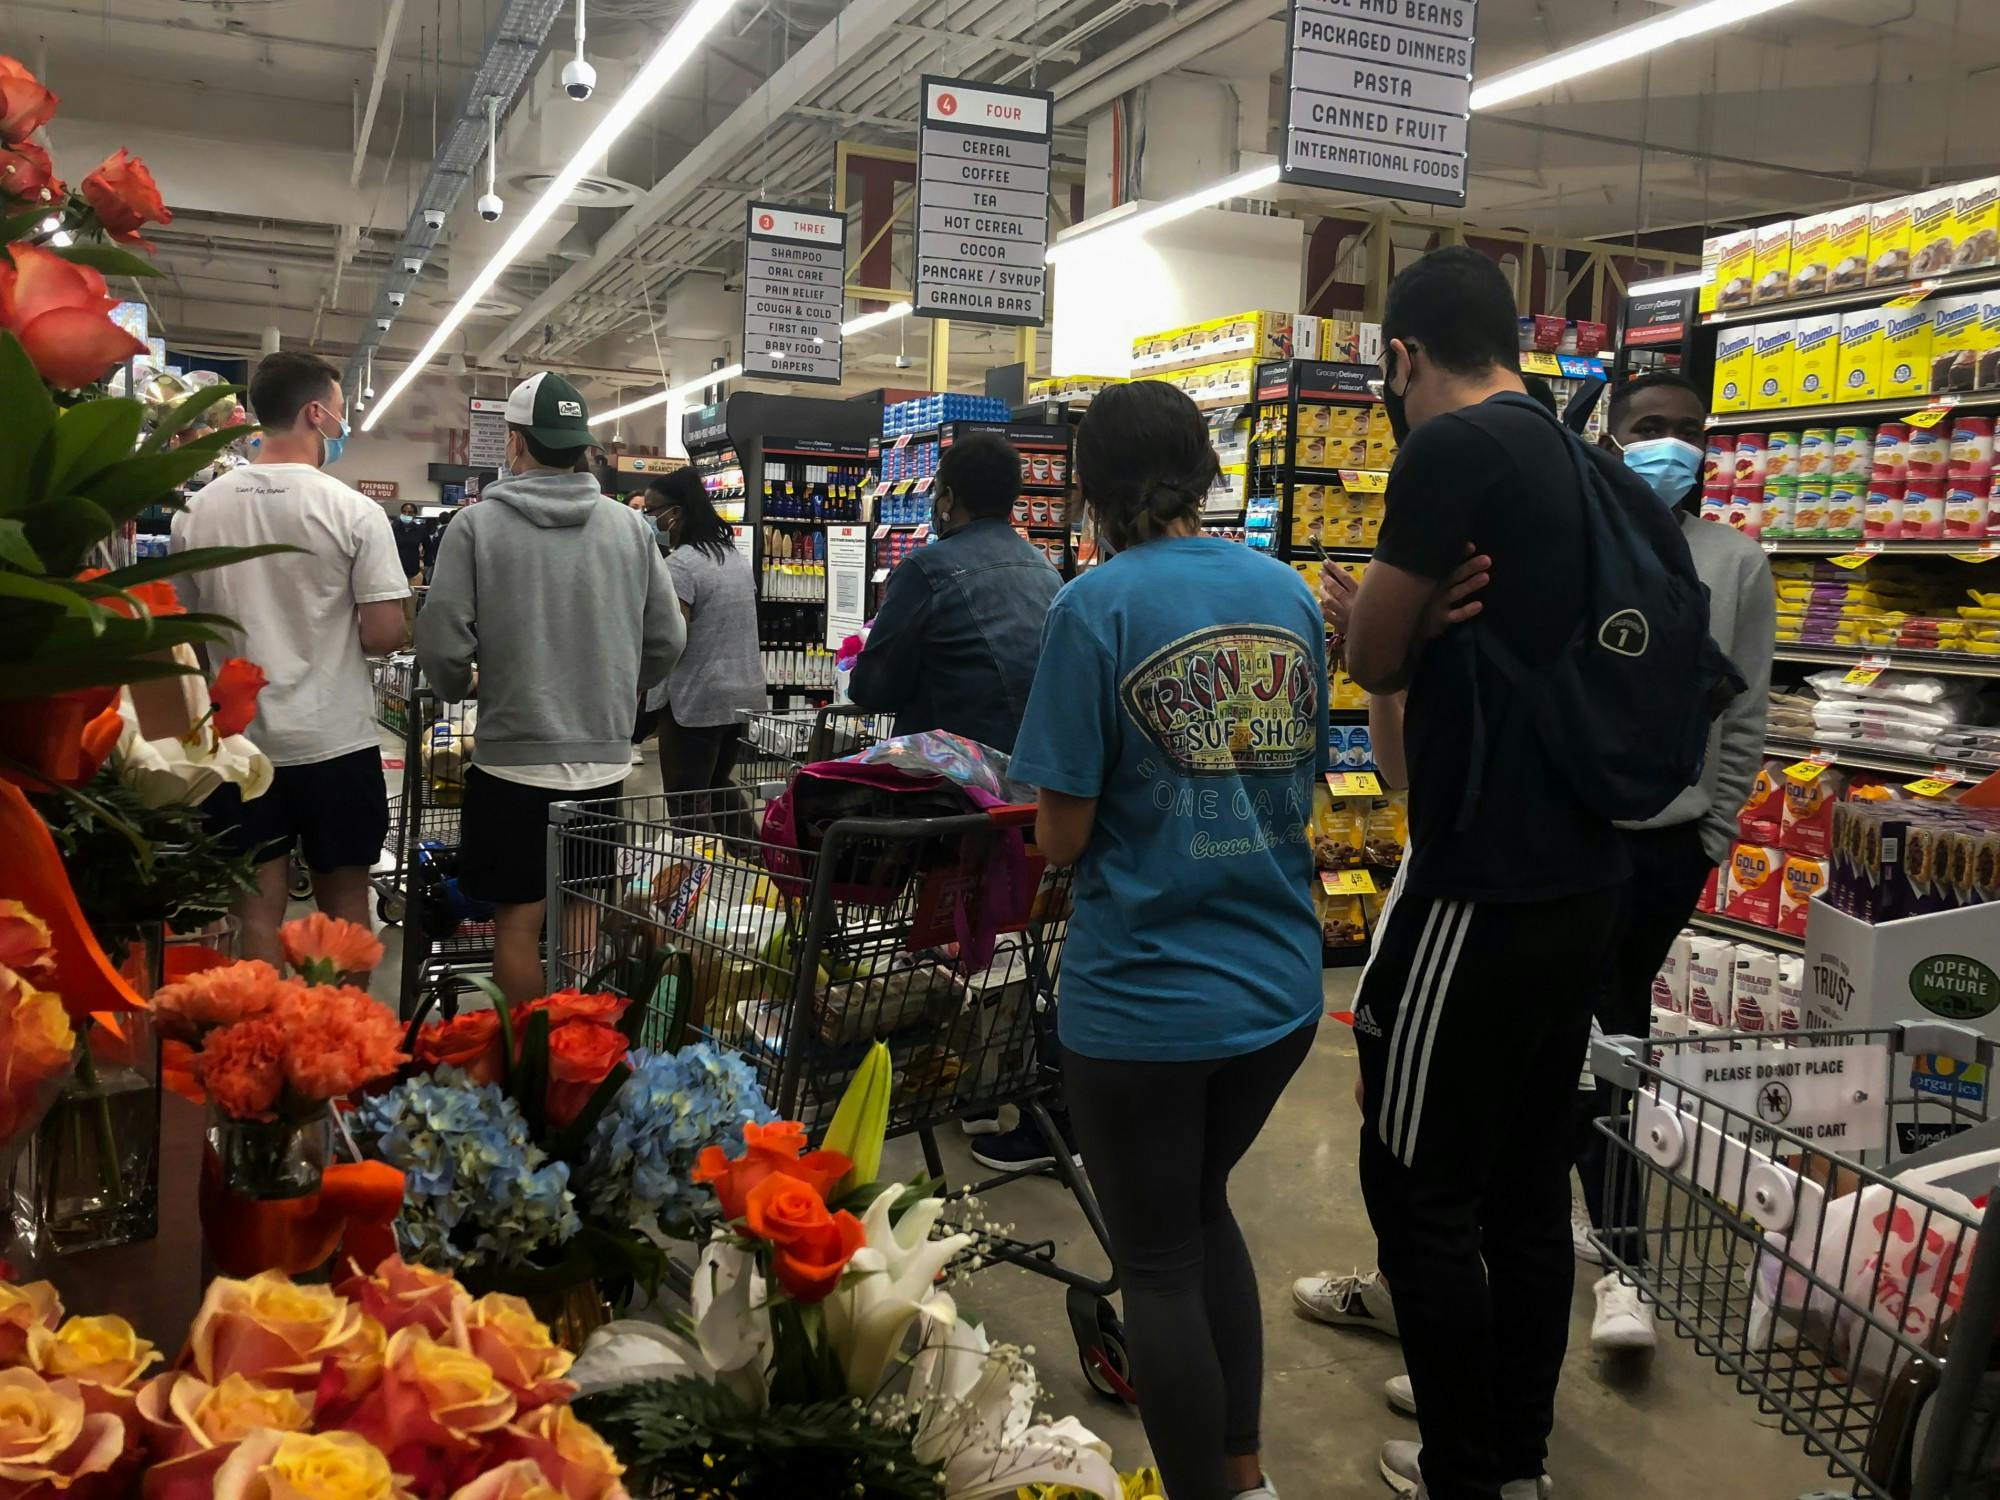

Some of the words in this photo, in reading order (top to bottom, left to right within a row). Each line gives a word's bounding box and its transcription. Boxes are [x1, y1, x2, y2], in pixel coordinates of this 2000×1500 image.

[1360, 0, 1398, 15] AND
[1405, 1, 1463, 28] BEANS
[1301, 20, 1391, 52] PACKAGED
[1397, 39, 1466, 67] DINNERS
[1353, 71, 1412, 98] PASTA
[943, 97, 951, 112] 4
[986, 104, 1021, 120] FOUR
[1312, 104, 1388, 133] CANNED
[1396, 118, 1447, 142] FRUIT
[963, 140, 1011, 158] CEREAL
[1295, 140, 1409, 172] INTERNATIONAL
[1413, 159, 1459, 179] FOODS
[962, 166, 1010, 183] COFFEE
[974, 193, 997, 207] TEA
[1914, 198, 1953, 223] Domino
[1957, 188, 1997, 214] Domino
[763, 216, 769, 228] 3
[793, 222, 826, 234] THREE
[944, 215, 971, 230] HOT
[975, 218, 1023, 236] CEREAL
[1831, 215, 1866, 238] Domino
[1872, 207, 1909, 231] Domino
[1756, 231, 1788, 255] Domino
[1792, 223, 1827, 246] Domino
[771, 247, 822, 262] SHAMPOO
[960, 242, 1006, 259] COCOA
[1720, 239, 1752, 260] Domino
[768, 266, 793, 278] ORAL
[797, 269, 824, 281] CARE
[923, 264, 983, 282] PANCAKE
[989, 269, 995, 283] /
[1000, 272, 1041, 287] SYRUP
[765, 284, 789, 296] PAIN
[792, 288, 824, 299] RELIEF
[931, 291, 992, 308] GRANOLA
[997, 297, 1032, 312] BARS
[757, 302, 792, 314] COUGH
[795, 305, 802, 316] &
[806, 308, 831, 319] COLD
[1936, 303, 1978, 325] Domino
[769, 322, 797, 334] FIRST
[801, 325, 818, 335] AID
[1843, 319, 1879, 341] Domino
[1887, 312, 1926, 335] Domino
[1720, 336, 1749, 356] Domino
[1757, 331, 1791, 351] Domino
[1798, 325, 1832, 346] Domino
[1892, 329, 1919, 343] SUGAR
[765, 341, 792, 352] BABY
[795, 343, 821, 354] FOOD
[771, 360, 814, 373] DIAPERS
[1316, 368, 1364, 380] GroceryDelivery
[361, 482, 394, 491] PREPARED
[1618, 628, 1629, 647] 1
[1152, 647, 1241, 730] RON
[1249, 716, 1307, 747] SHOP
[1153, 780, 1219, 819] ONE
[1786, 781, 1817, 800] GOLD
[1190, 830, 1252, 859] Cocoa
[1735, 853, 1766, 872] GOLD
[1786, 866, 1819, 885] GOLD
[1934, 960, 1980, 980] OPEN
[1813, 965, 1855, 1012] TRUST
[1923, 974, 1989, 996] NATURE
[1705, 1067, 1752, 1082] PLEASE
[1756, 1065, 1773, 1079] DO
[1777, 1063, 1801, 1077] NOT
[1806, 1060, 1844, 1075] PLACE
[1817, 1123, 1847, 1138] CART
